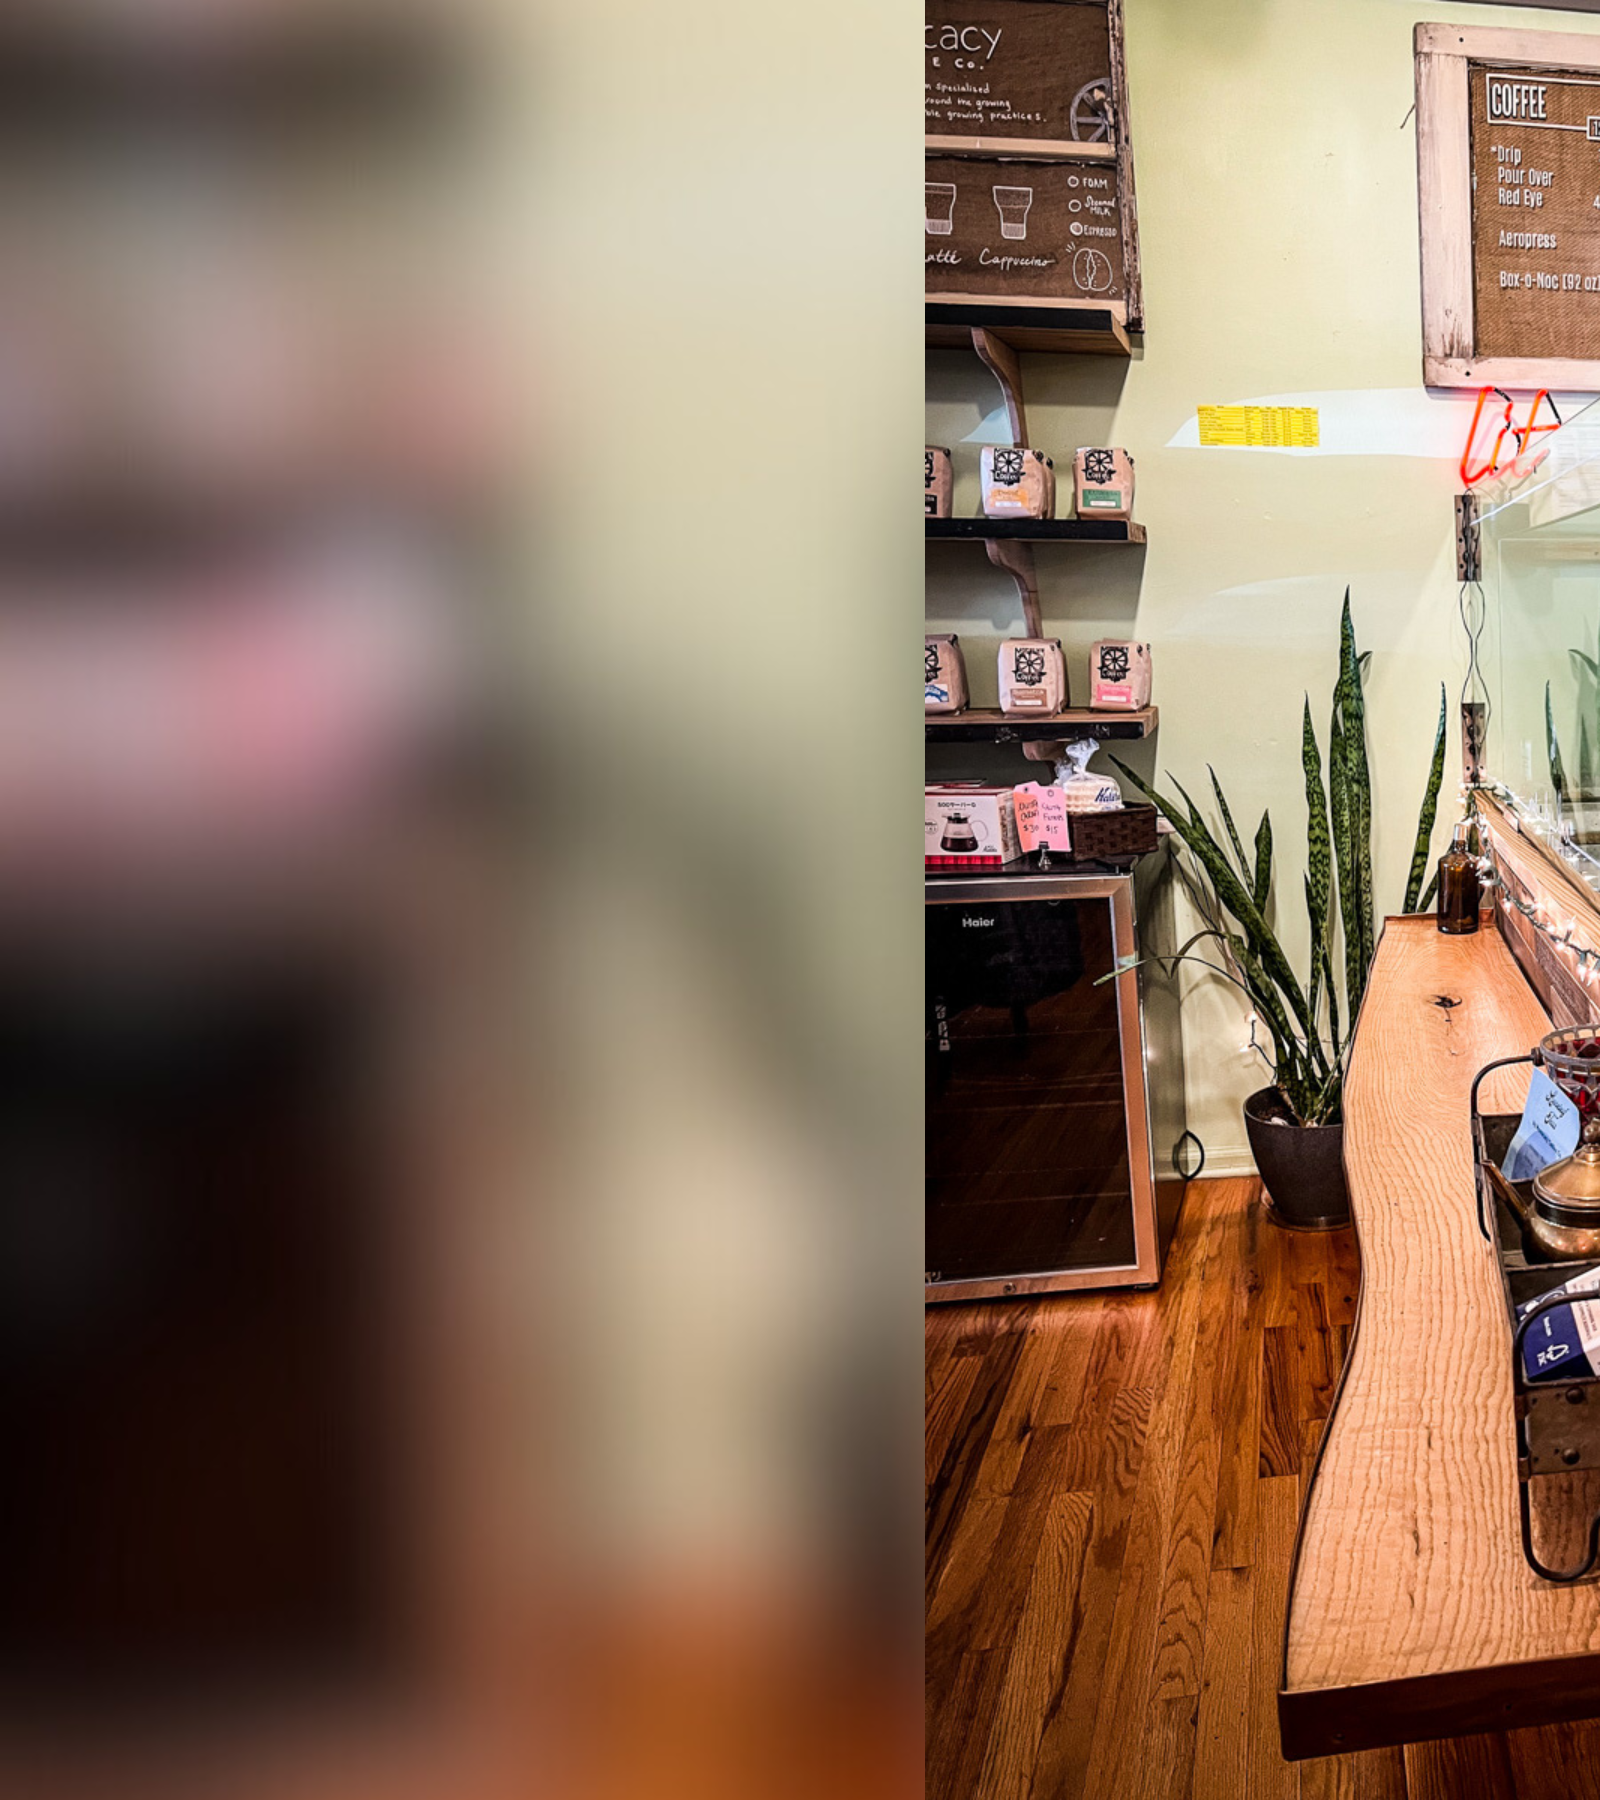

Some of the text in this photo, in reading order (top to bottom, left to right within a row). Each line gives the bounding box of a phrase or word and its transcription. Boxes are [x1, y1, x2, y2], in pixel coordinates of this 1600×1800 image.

[976, 98, 1011, 112] growing
[1491, 83, 1547, 119] COFFEE
[947, 110, 984, 123] growing
[1082, 177, 1108, 190] FOAM
[1498, 166, 1525, 184] Pour
[1528, 168, 1554, 187] Over
[1498, 187, 1520, 205] Red
[1524, 189, 1543, 208] Eye
[1499, 229, 1557, 250] Aeropress
[979, 247, 1055, 271] Cappuccino
[1500, 271, 1559, 290] Box-o-Noc
[962, 917, 995, 927] Haier
